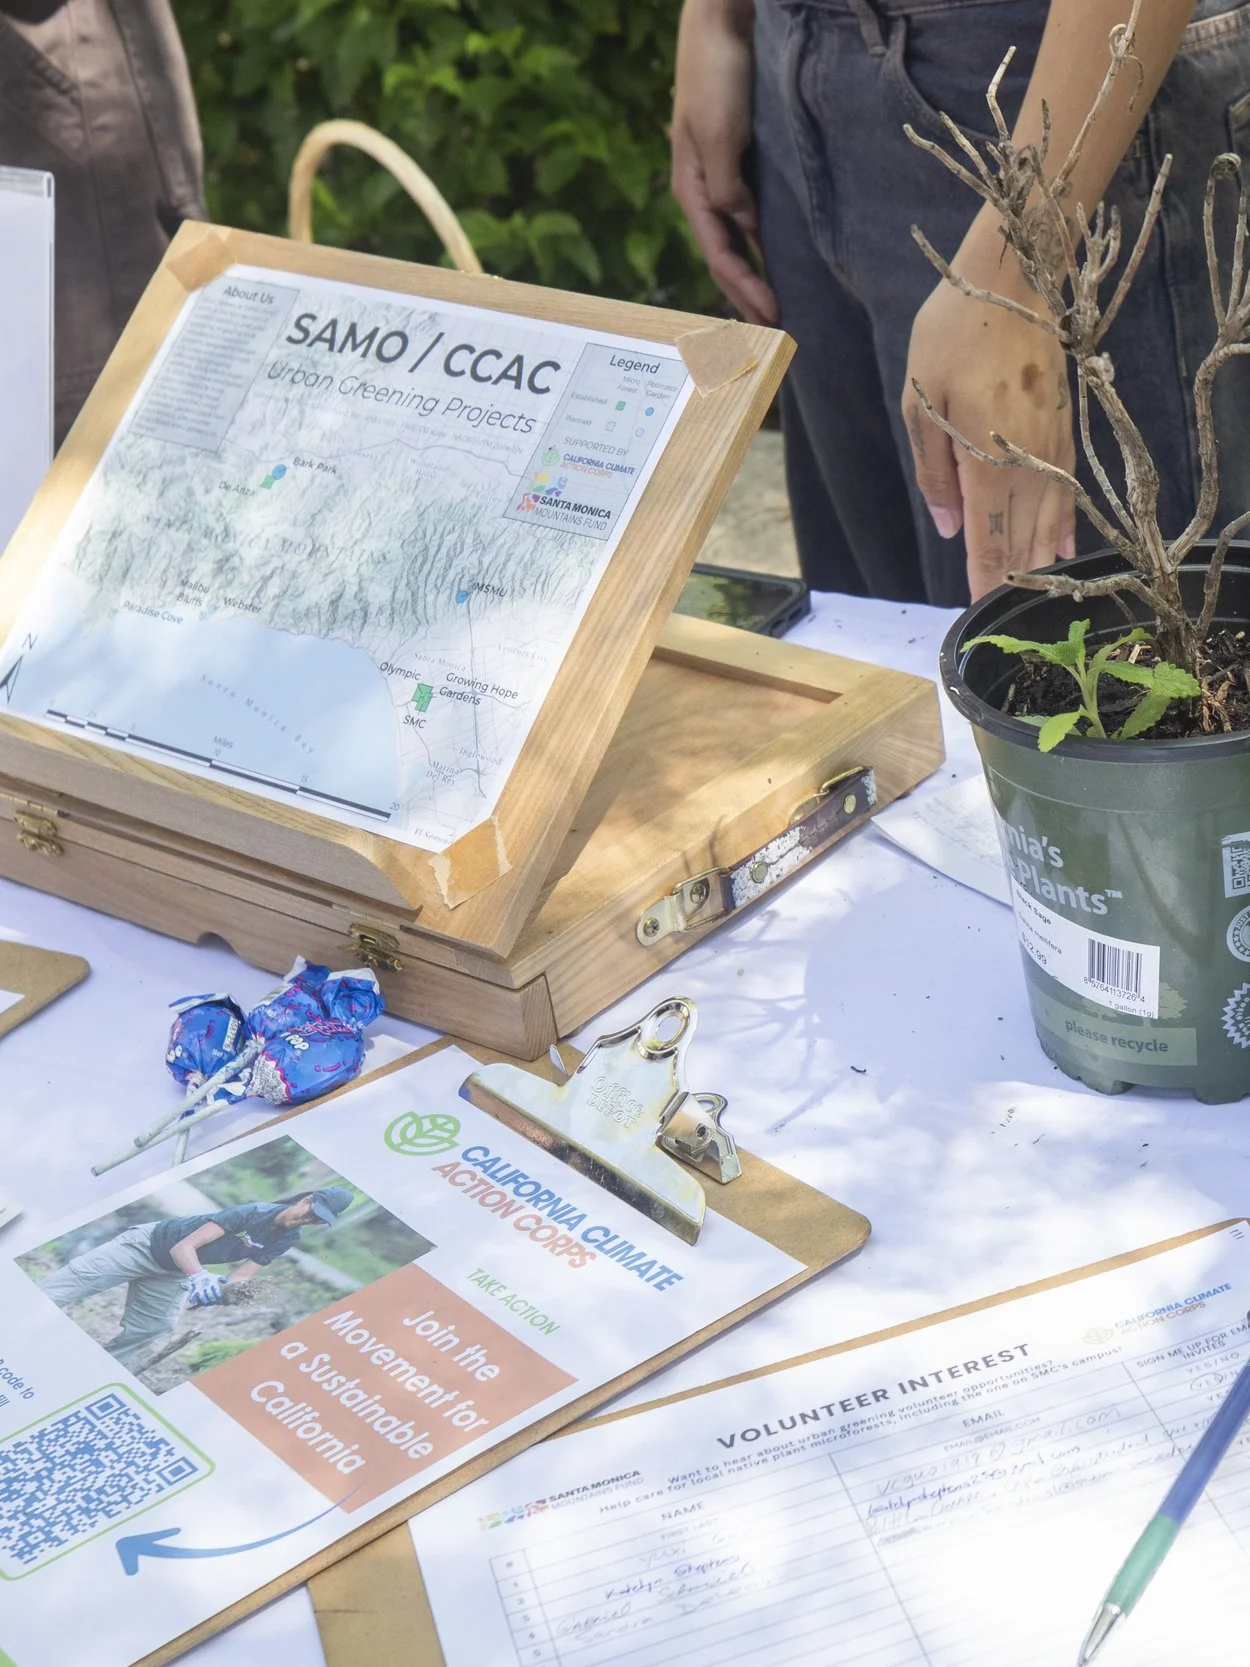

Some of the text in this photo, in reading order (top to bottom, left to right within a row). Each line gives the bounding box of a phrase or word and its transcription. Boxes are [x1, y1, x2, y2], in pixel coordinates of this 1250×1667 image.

[223, 286, 275, 304] About Us
[286, 313, 561, 395] SAMO / CCAC
[610, 354, 660, 375] Legend
[616, 384, 671, 400] Forest Garden
[646, 380, 678, 392] Pollinator
[267, 360, 536, 434] Urban Greening Projects
[570, 392, 608, 405] Established
[565, 415, 592, 426] Planned
[563, 436, 629, 457] SUPPORTED BY
[292, 456, 337, 475] Bark Park
[560, 462, 613, 478] ACTION CORPS
[563, 453, 636, 475] CALIFORNIA CLIMATE
[218, 480, 256, 497] De Anza
[539, 496, 612, 519] SANTA MONICA
[534, 507, 608, 531] MOUNTAINS FUND
[178, 578, 210, 595] Malibu
[474, 582, 508, 597] MSMU
[177, 592, 203, 608] Bluffs
[223, 595, 263, 615] Webster
[123, 600, 184, 625] Paradise Cove
[22, 633, 39, 651] N
[379, 662, 421, 681] Olympic
[439, 686, 481, 705] Gardens
[445, 672, 519, 700] Growing Hope
[403, 715, 427, 729] SMC
[211, 735, 234, 750] Miles
[459, 747, 503, 765] Inglewood
[425, 770, 439, 781] Del
[431, 760, 461, 775] Marina
[390, 801, 400, 811] 20
[1033, 907, 1051, 925] Sage
[1114, 1001, 1137, 1014] gallon
[1065, 1018, 1169, 1053] please recycle
[592, 1076, 646, 1118] Office
[586, 1093, 635, 1128] DEPOT
[430, 1161, 598, 1270] ACTION CORPS
[461, 1145, 685, 1292] CALIFORNIA CLIMATE
[466, 1267, 560, 1336] TAKE ACTION
[1114, 1283, 1232, 1329] CALIFORNIA CLIMATE
[1120, 1301, 1206, 1335] ACTION CORPS
[403, 1310, 500, 1382] Join the
[1136, 1332, 1228, 1368] SIGN ME UP FOR
[1182, 1341, 1227, 1360] INVITES
[322, 1310, 490, 1433] Movement for
[1186, 1351, 1240, 1375] YES/NO
[19, 1386, 34, 1399] to
[279, 1341, 434, 1459] a Sustainable
[716, 1343, 1031, 1449] VOLUNTEER INTEREST
[249, 1379, 367, 1475] California
[667, 1359, 1053, 1485] Want to hear about urban greening volunteer opportunities?
[962, 1408, 1005, 1428] EMAIL
[599, 1499, 627, 1514] Help
[634, 1489, 664, 1503] care
[667, 1478, 690, 1493] for
[690, 1469, 724, 1486] local
[727, 1454, 770, 1476] native
[772, 1442, 807, 1461] plant
[809, 1416, 897, 1449] microforests,
[898, 1396, 960, 1422] including
[961, 1389, 983, 1401] the
[985, 1382, 1010, 1394] one
[1012, 1376, 1029, 1387] on
[1030, 1361, 1069, 1381] SMC's
[548, 1470, 641, 1503] SANTA MONICA
[550, 1477, 644, 1511] MOUNTAINS FUND
[661, 1501, 706, 1522] NAME
[659, 1525, 688, 1541] FIRST
